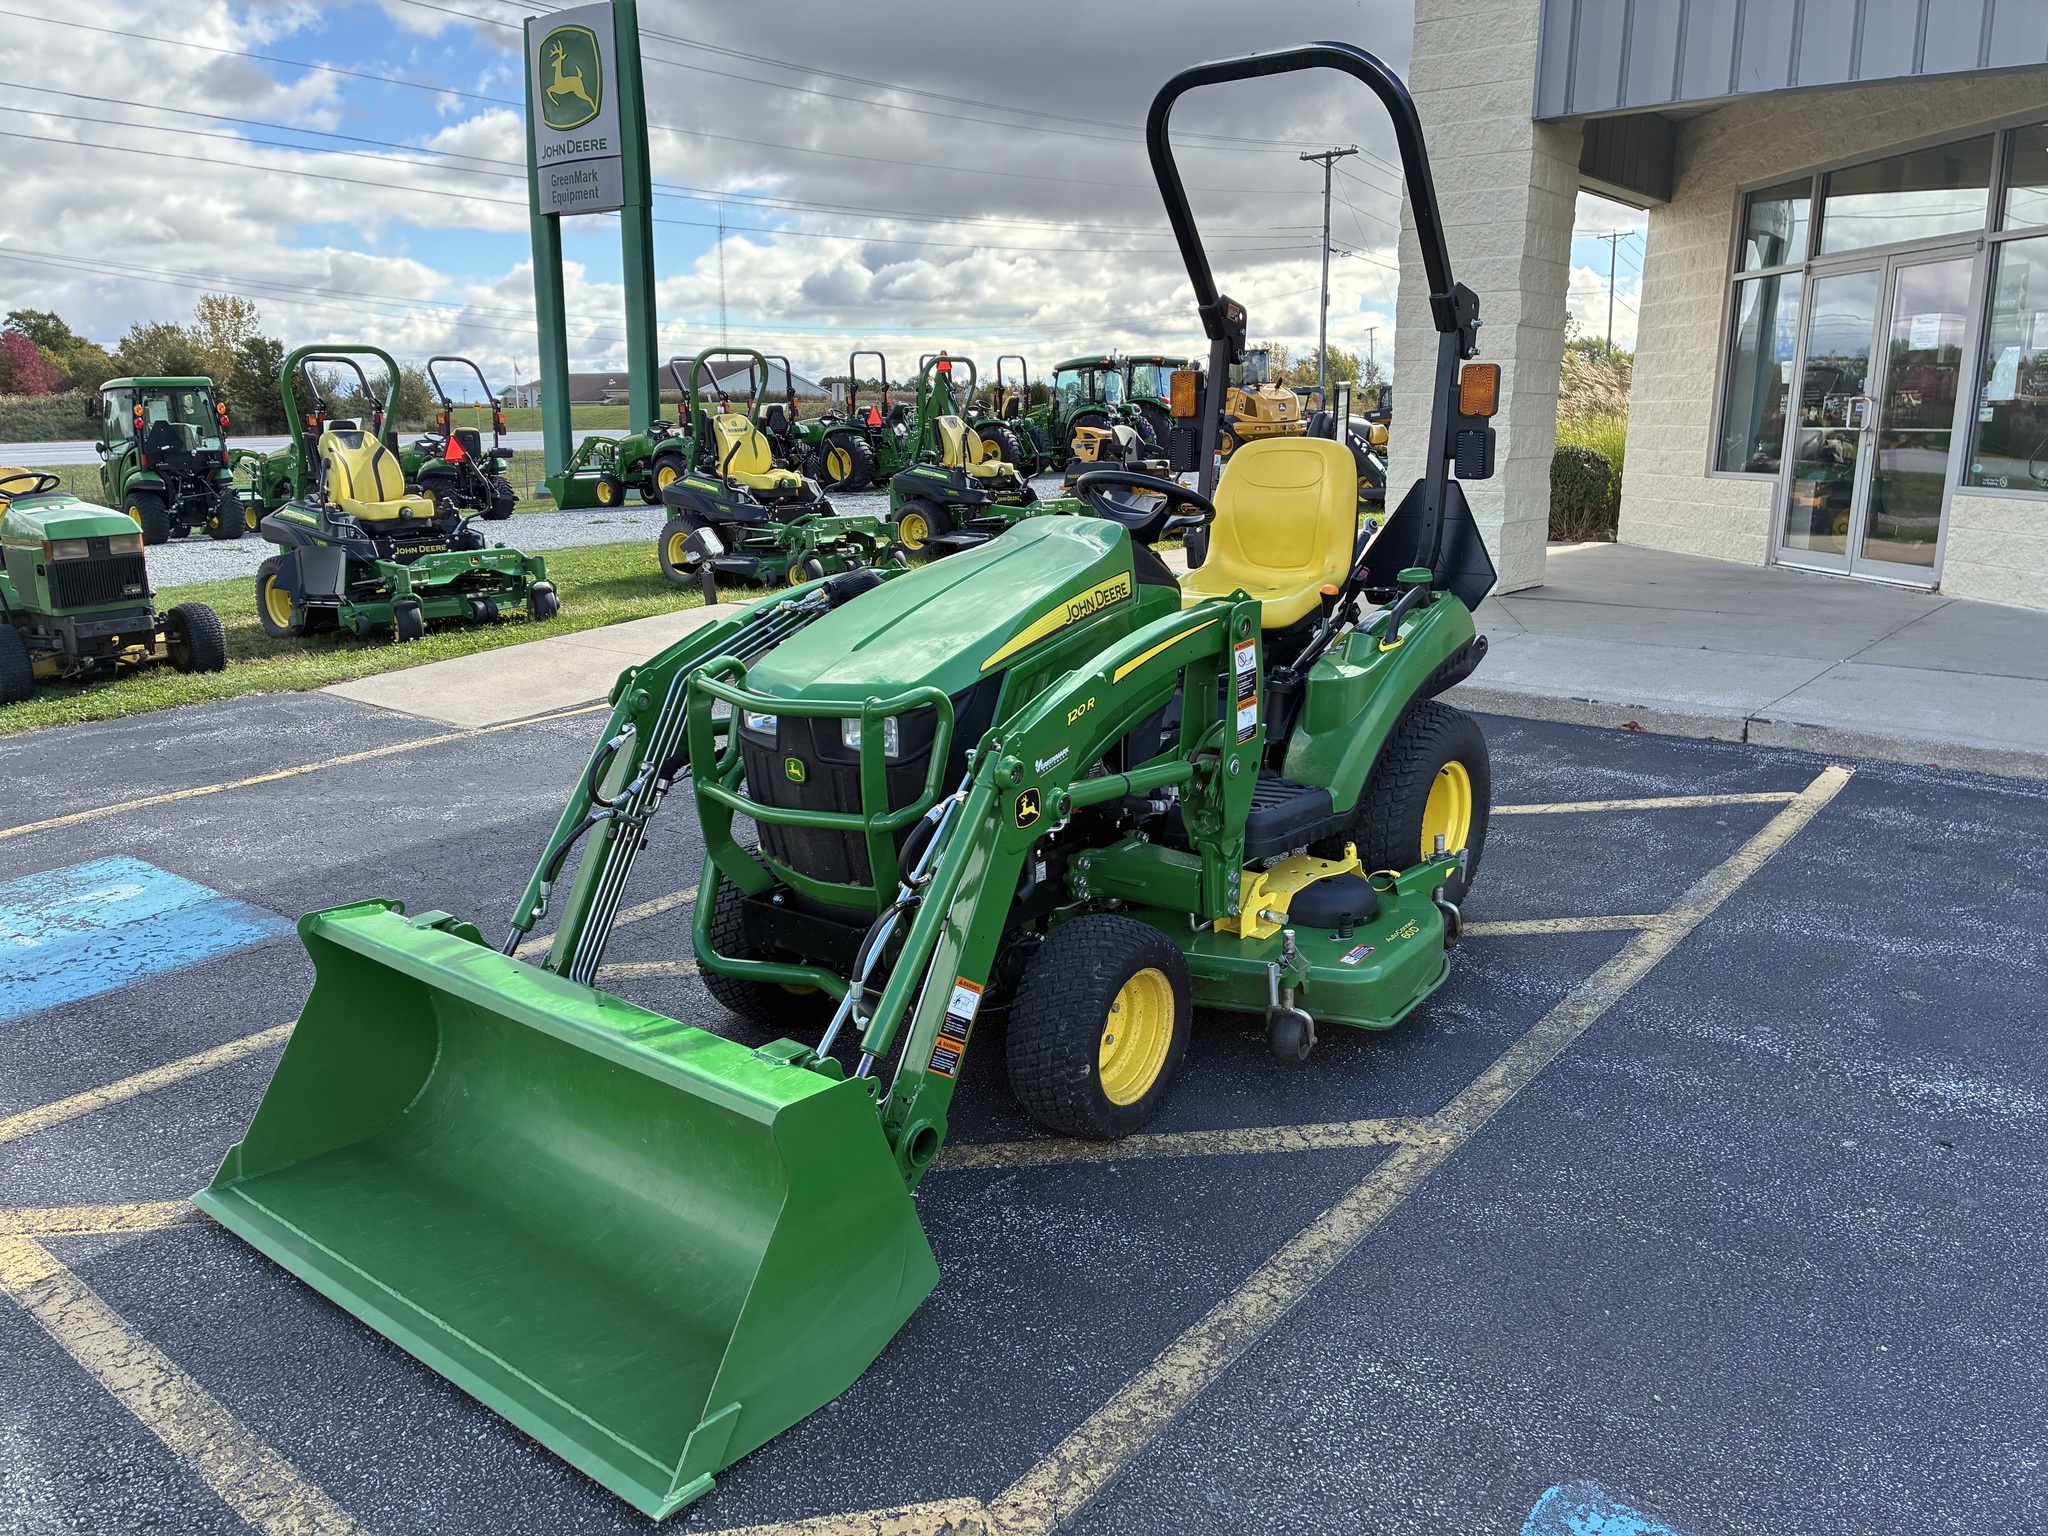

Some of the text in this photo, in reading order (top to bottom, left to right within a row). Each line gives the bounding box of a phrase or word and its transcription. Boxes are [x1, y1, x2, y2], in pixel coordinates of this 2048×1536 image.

[542, 138, 607, 159] JOHN DEERE
[551, 169, 598, 187] GreenMark
[552, 186, 599, 206] Equipment
[395, 544, 447, 555] JOHN DEERE
[1066, 582, 1128, 622] JOHN DEERE
[1385, 918, 1417, 942] AutoConnect
[1401, 926, 1420, 939] 60D
